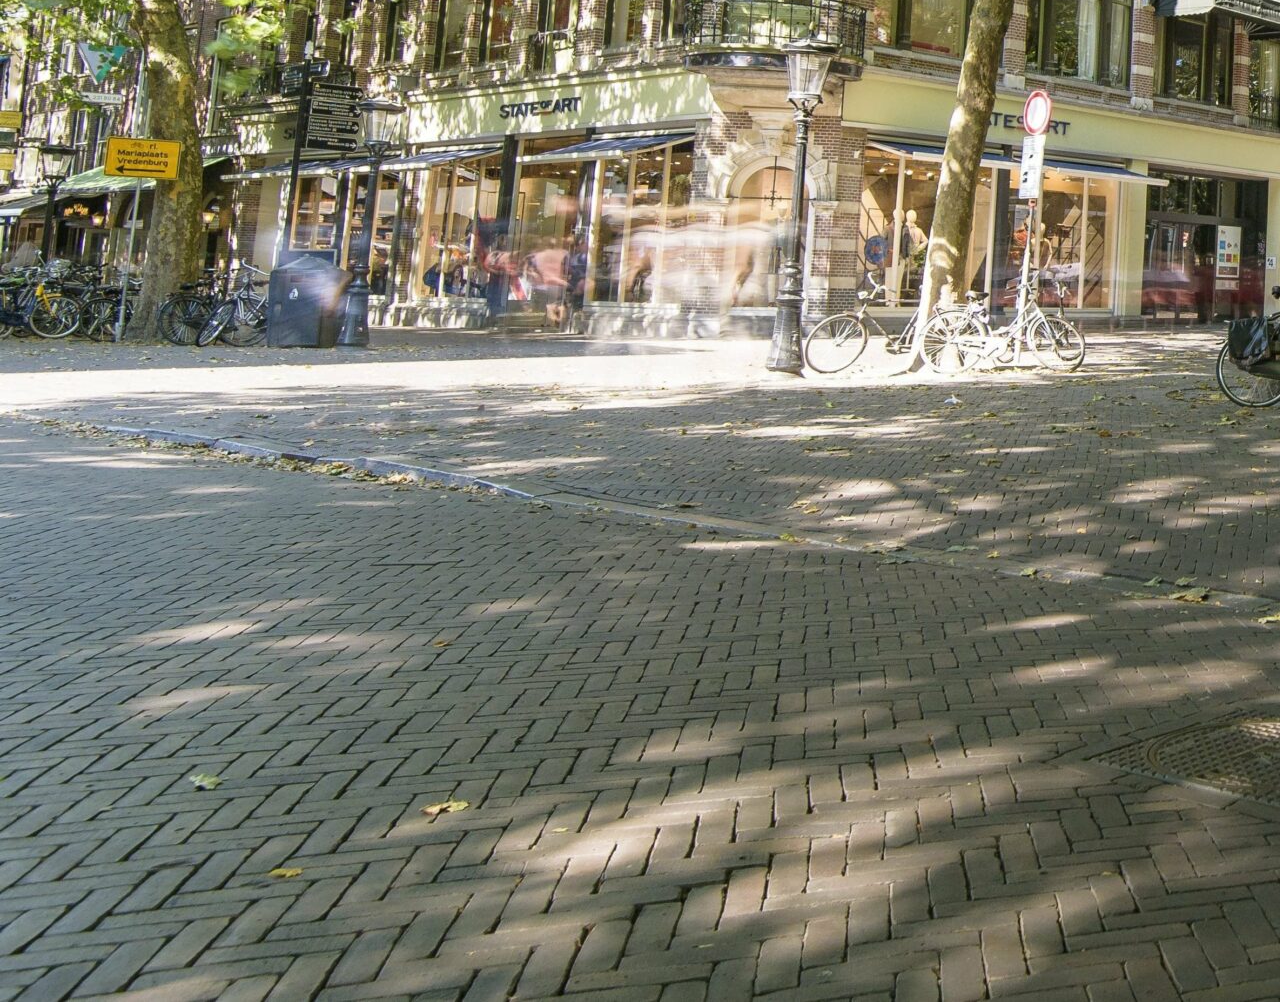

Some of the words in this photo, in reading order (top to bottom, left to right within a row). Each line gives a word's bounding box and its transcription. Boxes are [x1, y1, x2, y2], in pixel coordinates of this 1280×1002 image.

[500, 102, 538, 119] STATE
[540, 100, 554, 108] OF
[552, 96, 581, 114] ART
[1047, 120, 1070, 136] RT
[117, 150, 168, 158] Mariaplaats
[117, 157, 168, 168] Vredenburg
